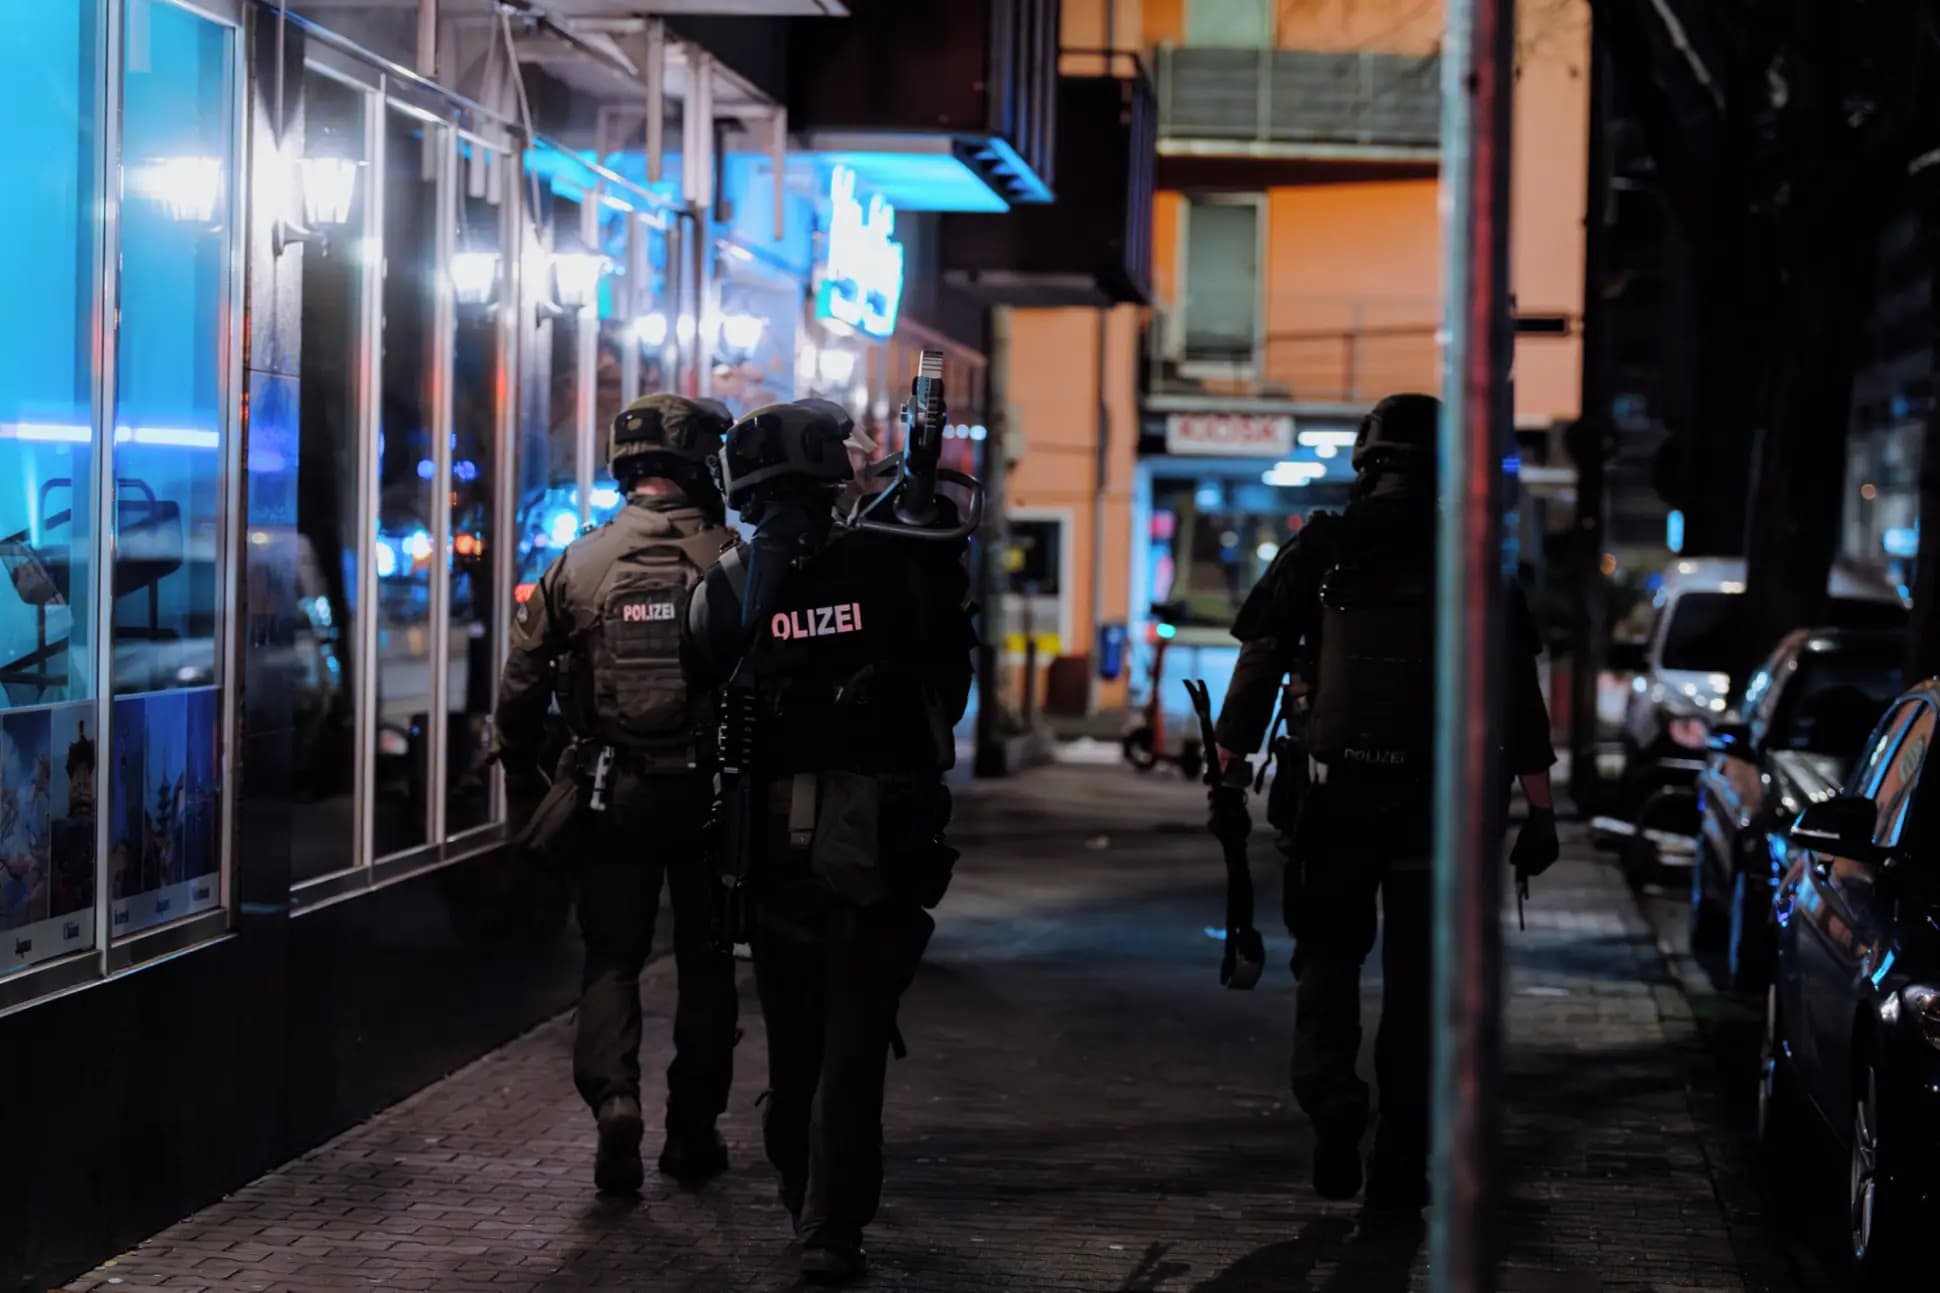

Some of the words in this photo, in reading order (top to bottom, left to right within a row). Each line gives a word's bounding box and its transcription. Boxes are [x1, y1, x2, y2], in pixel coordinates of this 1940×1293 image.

[623, 602, 675, 621] POLIZEI
[770, 602, 863, 641] OLIZEI
[1343, 747, 1406, 766] POLIZEI
